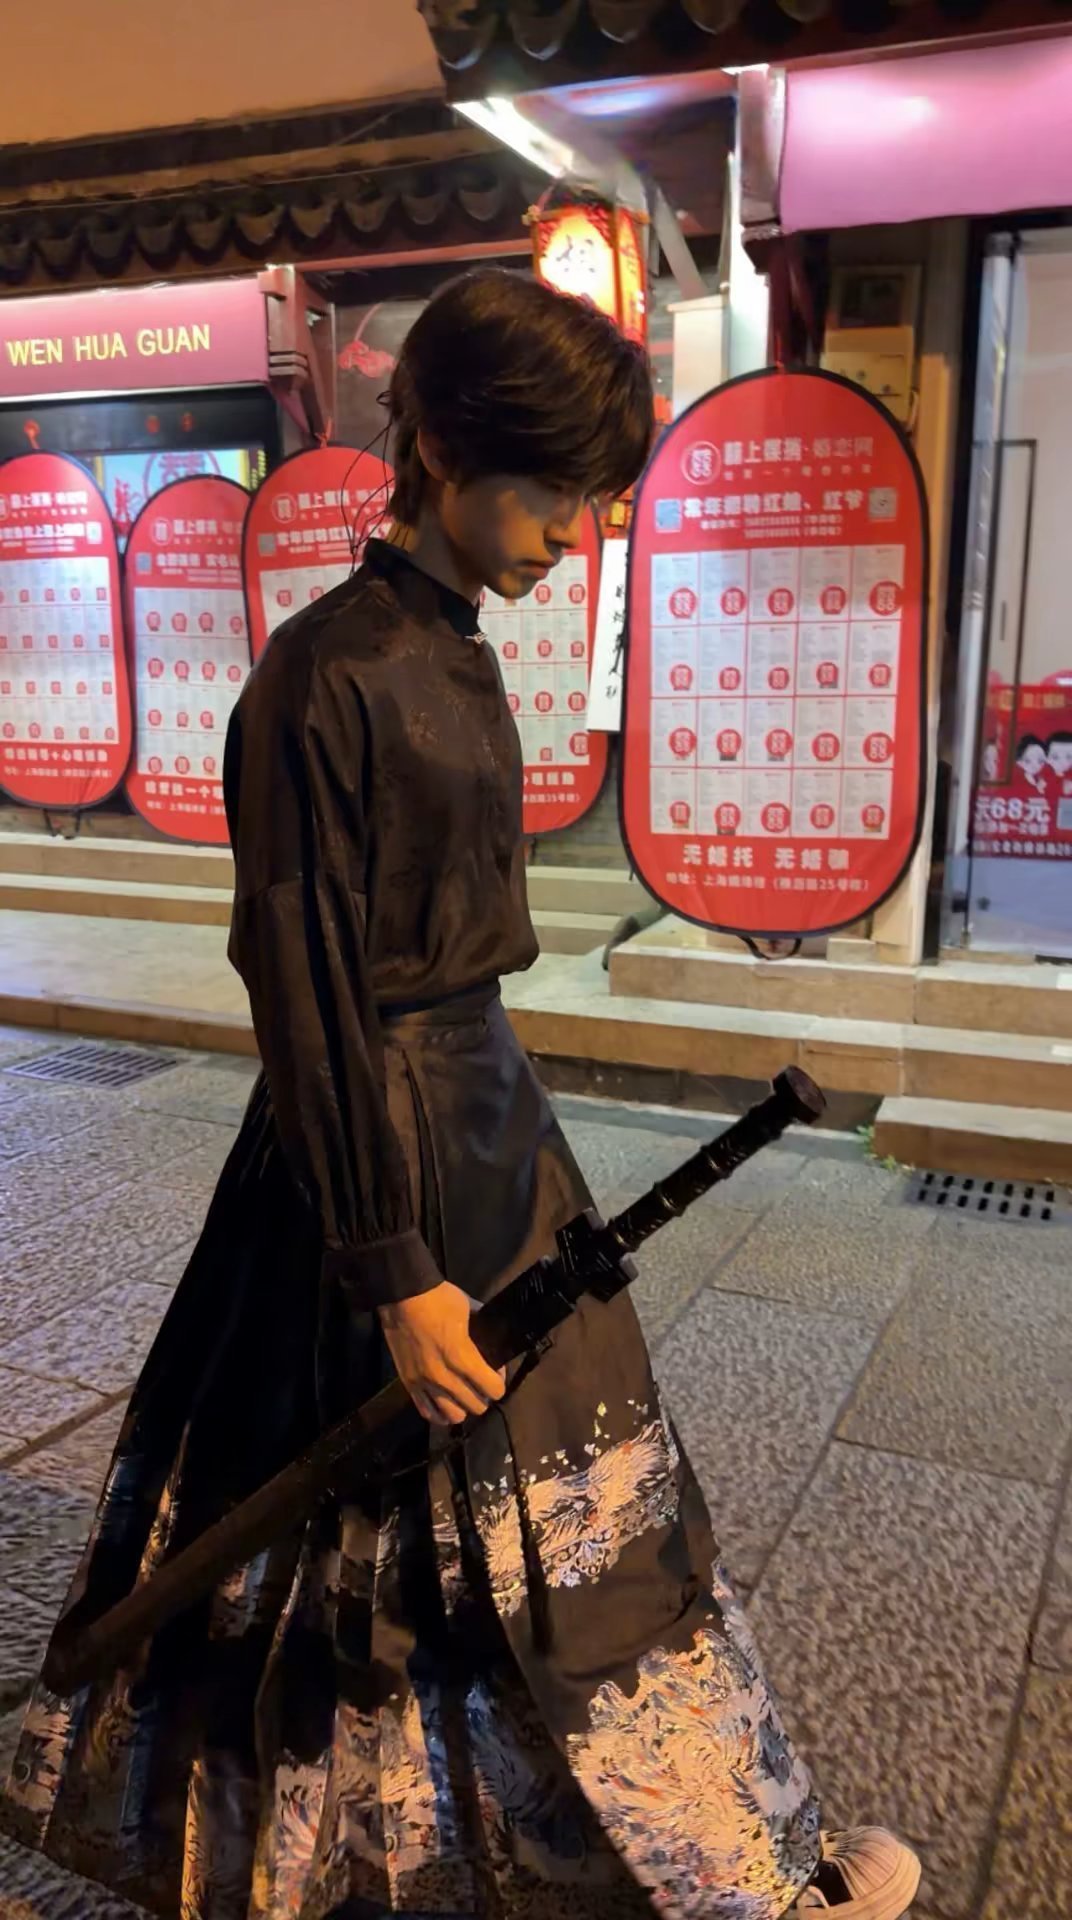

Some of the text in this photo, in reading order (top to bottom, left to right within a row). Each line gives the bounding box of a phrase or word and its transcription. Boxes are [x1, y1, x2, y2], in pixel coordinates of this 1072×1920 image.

[6, 323, 211, 367] WEN HUA GUAN
